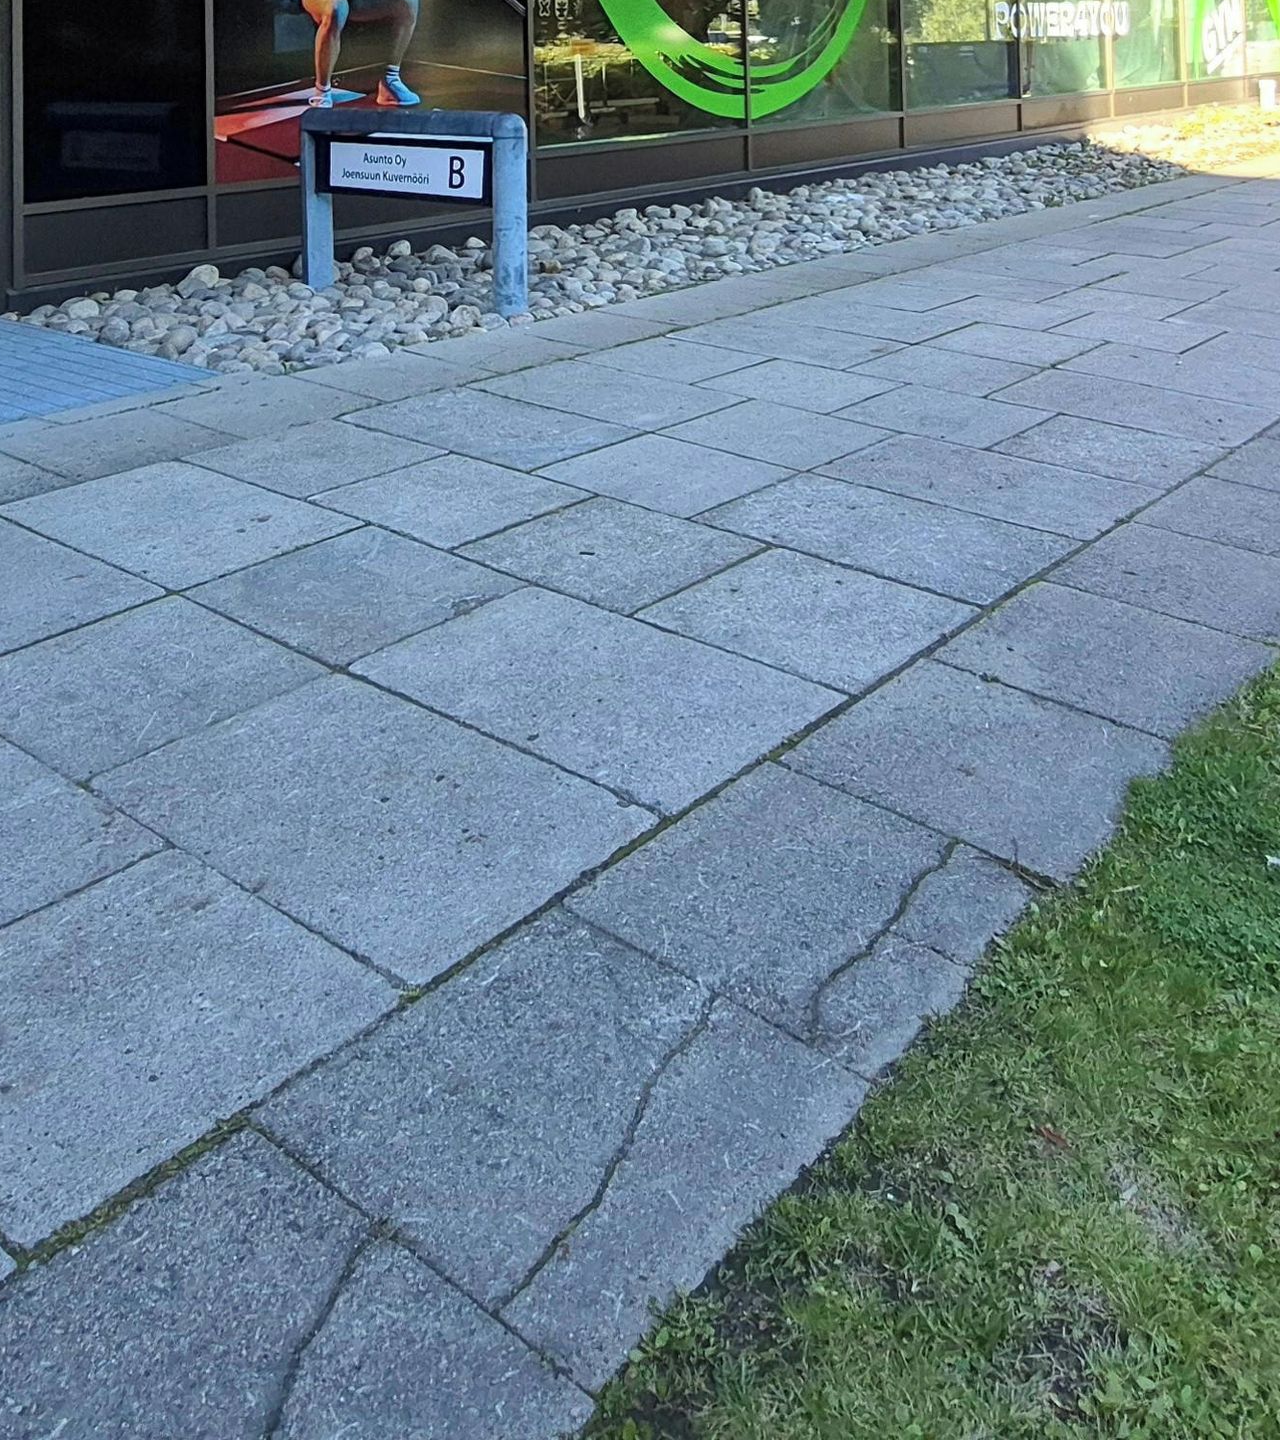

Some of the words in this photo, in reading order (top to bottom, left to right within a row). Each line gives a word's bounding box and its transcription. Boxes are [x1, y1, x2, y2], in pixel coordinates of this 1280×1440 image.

[991, 0, 1130, 40] POWER4YOU
[363, 153, 392, 165] Asunto
[394, 154, 407, 168] Oy
[448, 156, 465, 189] B
[341, 168, 381, 180] Joensuun
[382, 171, 430, 185] Kuvernööri
